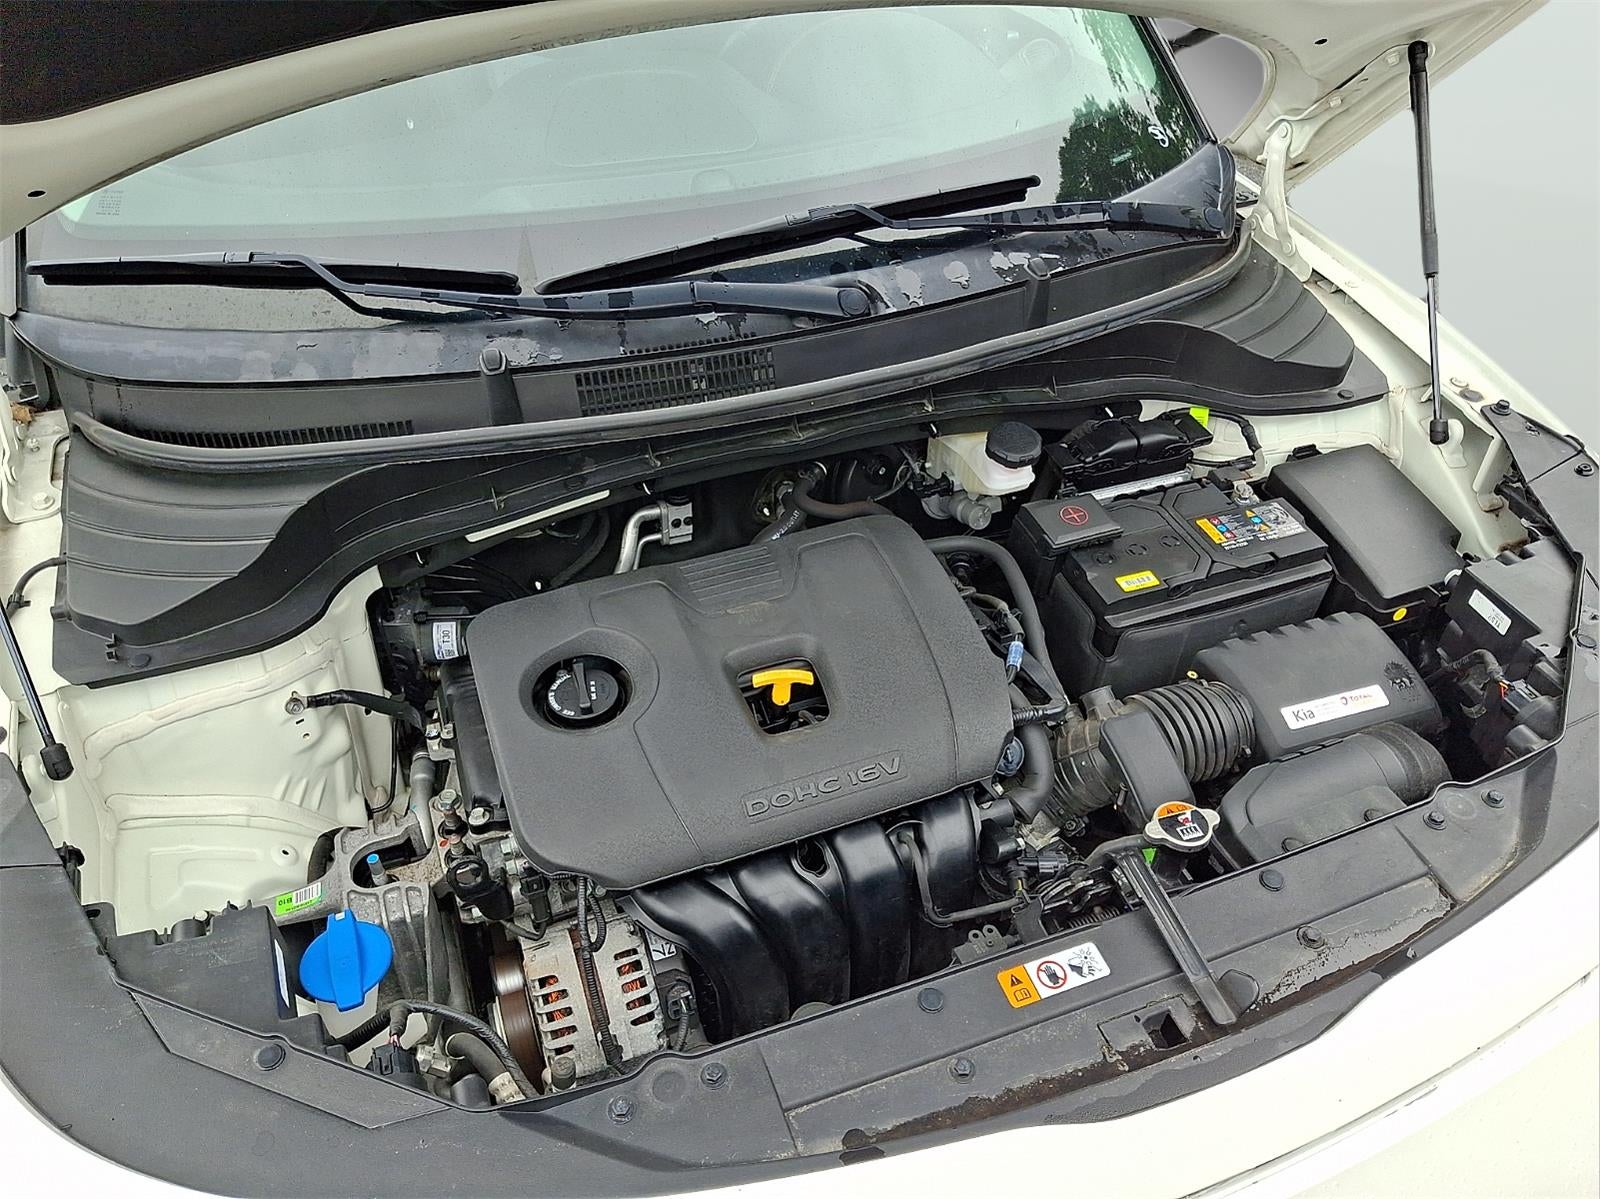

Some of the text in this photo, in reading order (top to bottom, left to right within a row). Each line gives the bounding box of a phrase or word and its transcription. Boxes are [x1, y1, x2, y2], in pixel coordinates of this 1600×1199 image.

[441, 629, 451, 644] T30
[1292, 708, 1316, 723] Kia
[743, 756, 900, 817] DOHC 16V
